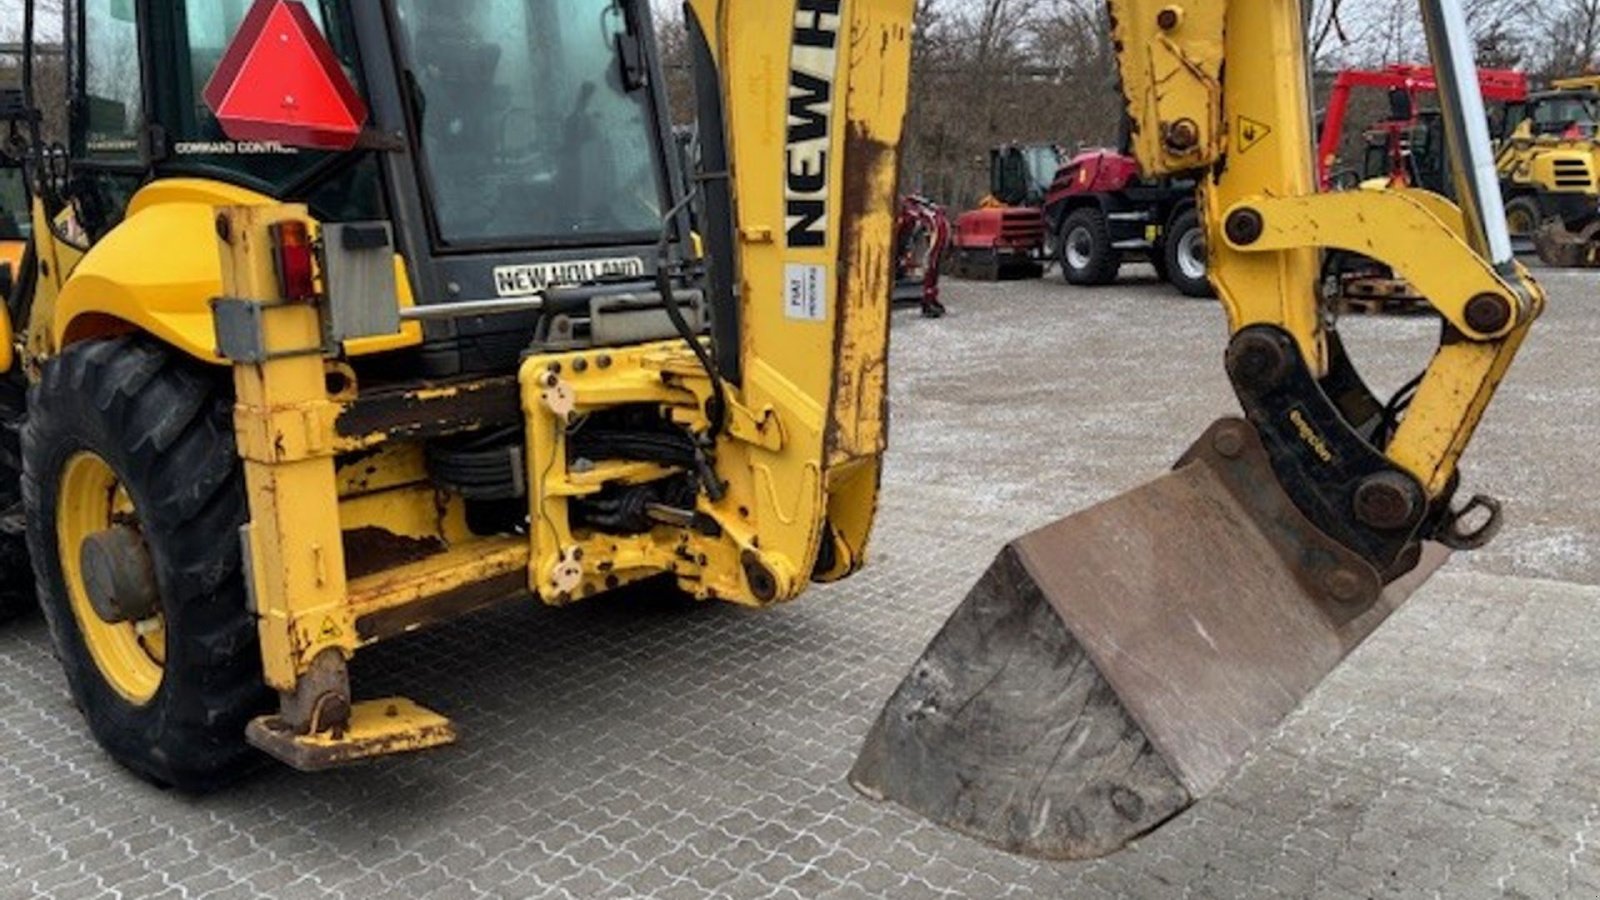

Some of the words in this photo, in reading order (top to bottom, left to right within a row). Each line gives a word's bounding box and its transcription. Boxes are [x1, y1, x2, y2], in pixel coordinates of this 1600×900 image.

[174, 141, 236, 154] COMMAND
[785, 68, 832, 248] NEW
[497, 266, 547, 292] NEW
